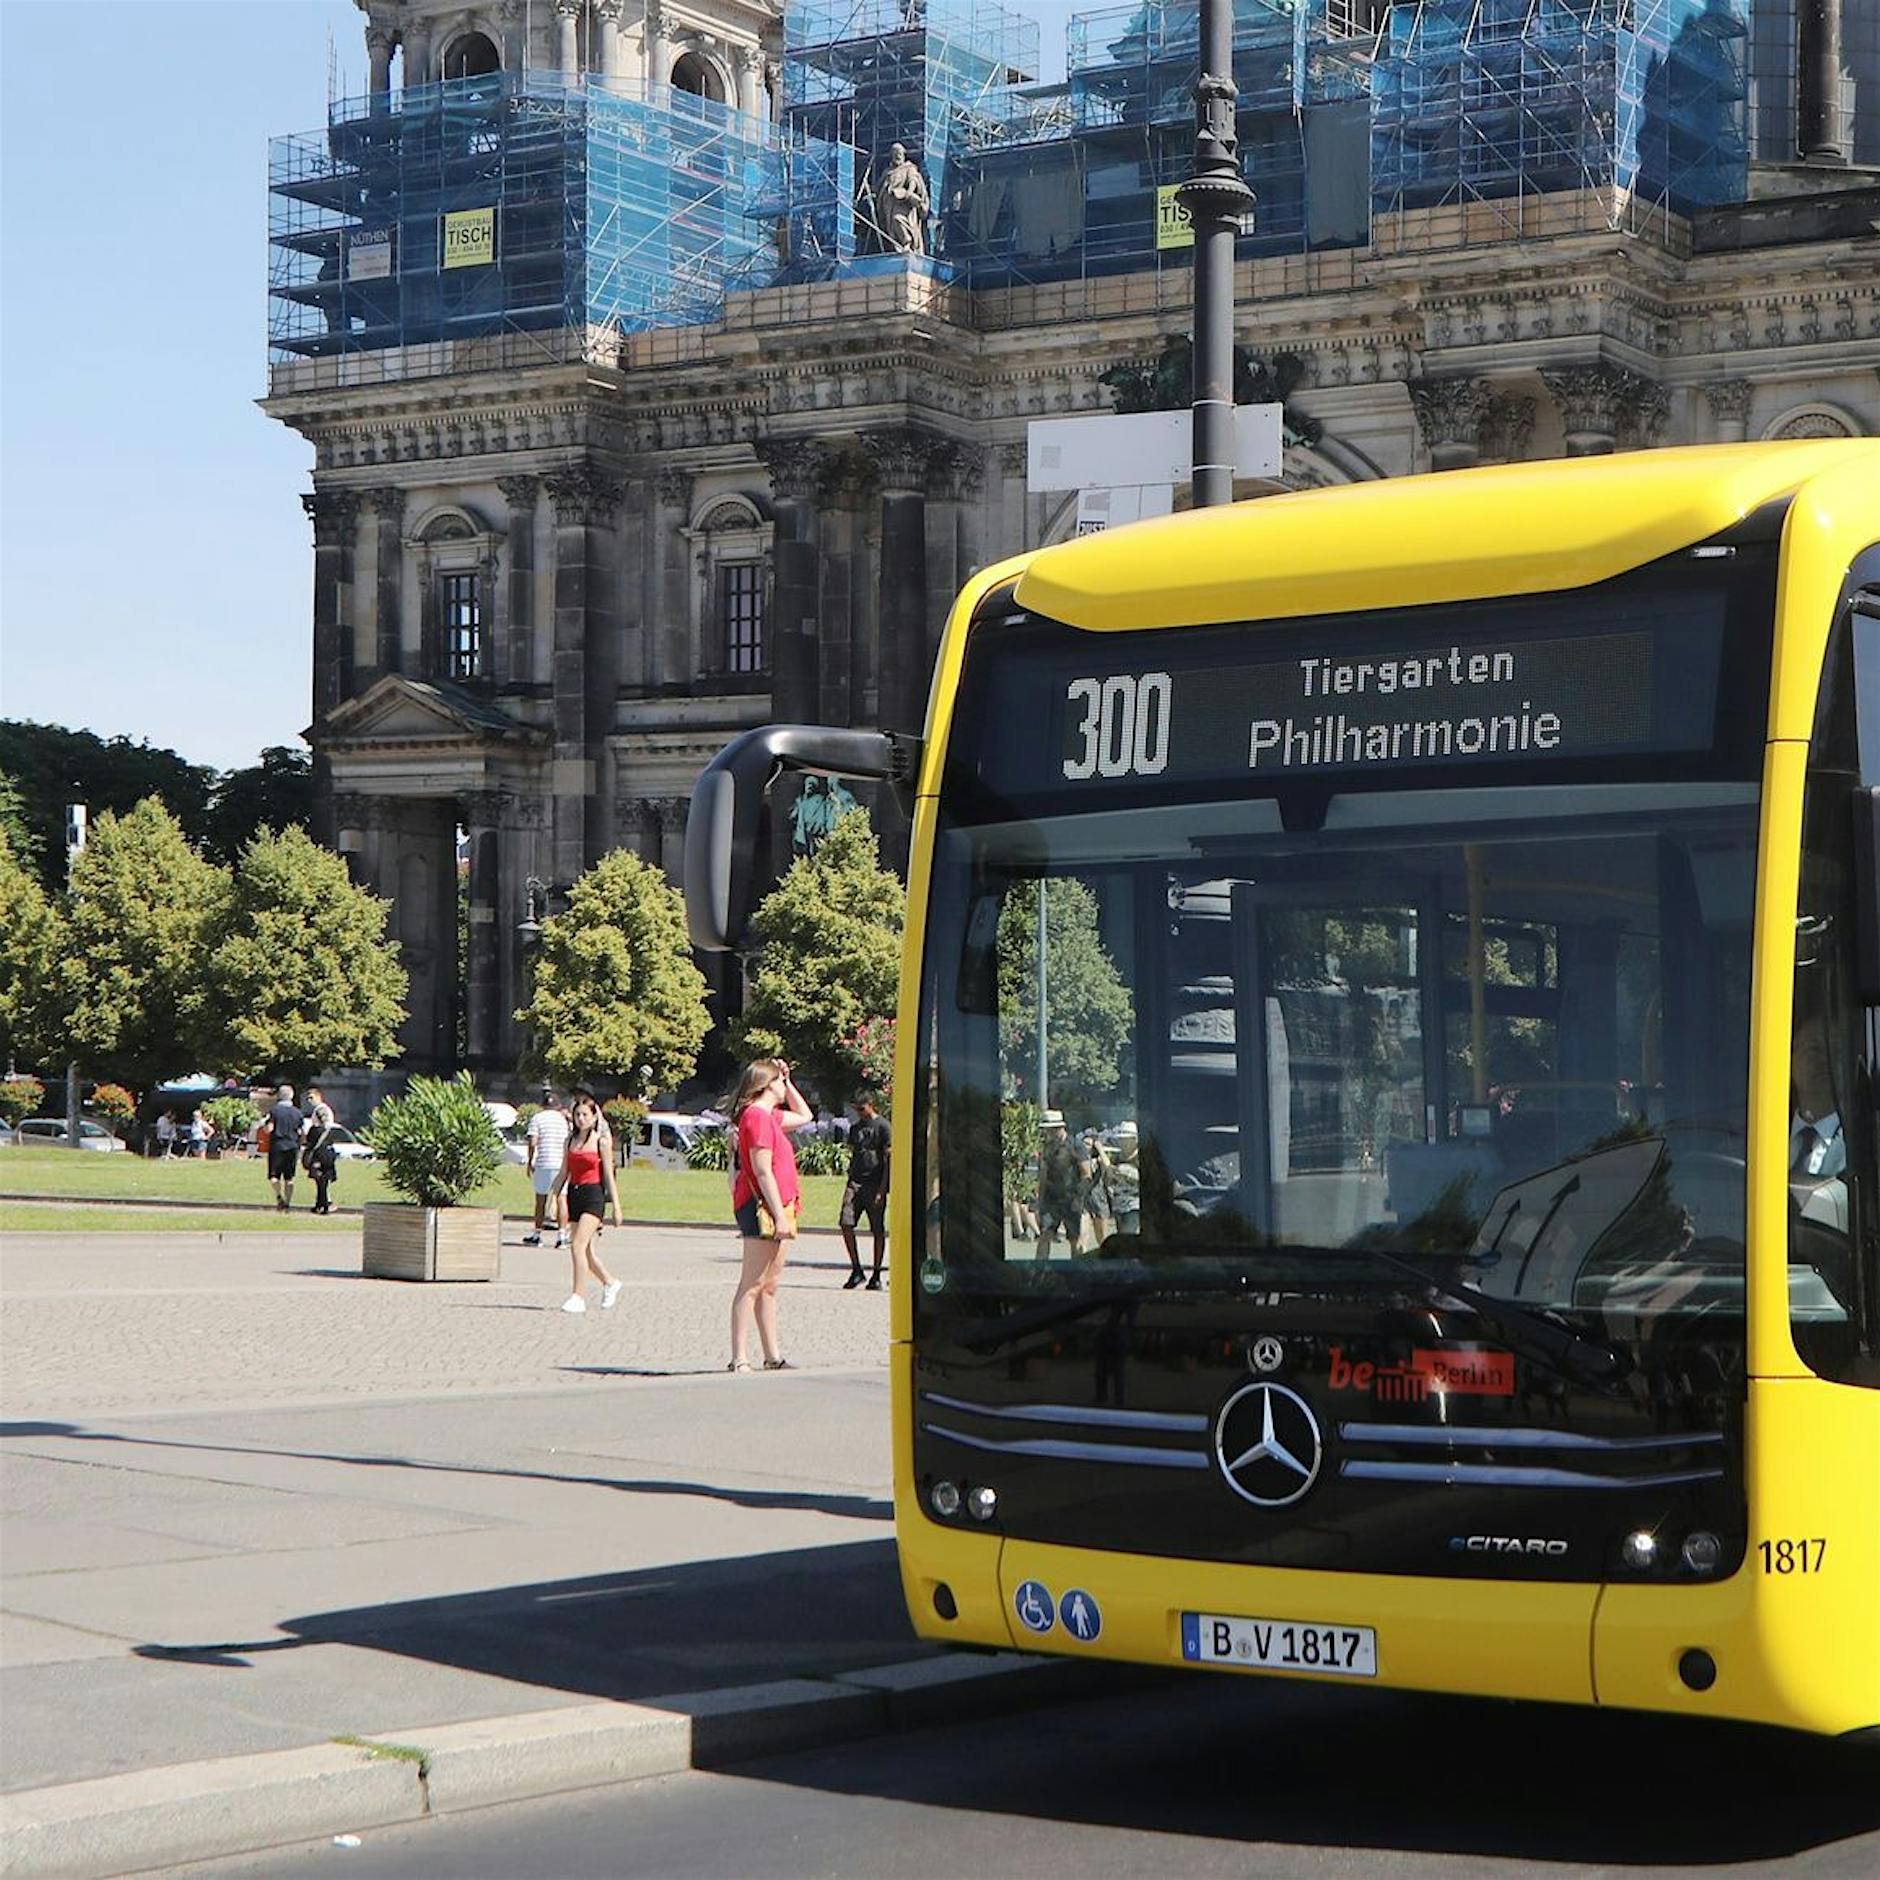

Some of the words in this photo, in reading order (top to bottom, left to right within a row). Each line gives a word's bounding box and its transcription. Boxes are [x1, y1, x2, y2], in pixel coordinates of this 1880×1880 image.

[448, 226, 491, 246] TISCH
[1160, 205, 1190, 223] TIS
[1299, 646, 1514, 697] Tiergarten
[1062, 671, 1173, 780] 300
[1248, 700, 1561, 769] Philharmonie
[1327, 1345, 1375, 1392] be
[1433, 1360, 1503, 1386] Berlin
[1758, 1538, 1826, 1574] 1817
[1213, 1621, 1232, 1656] B
[1253, 1624, 1273, 1660] V
[1282, 1627, 1361, 1668] 1817
